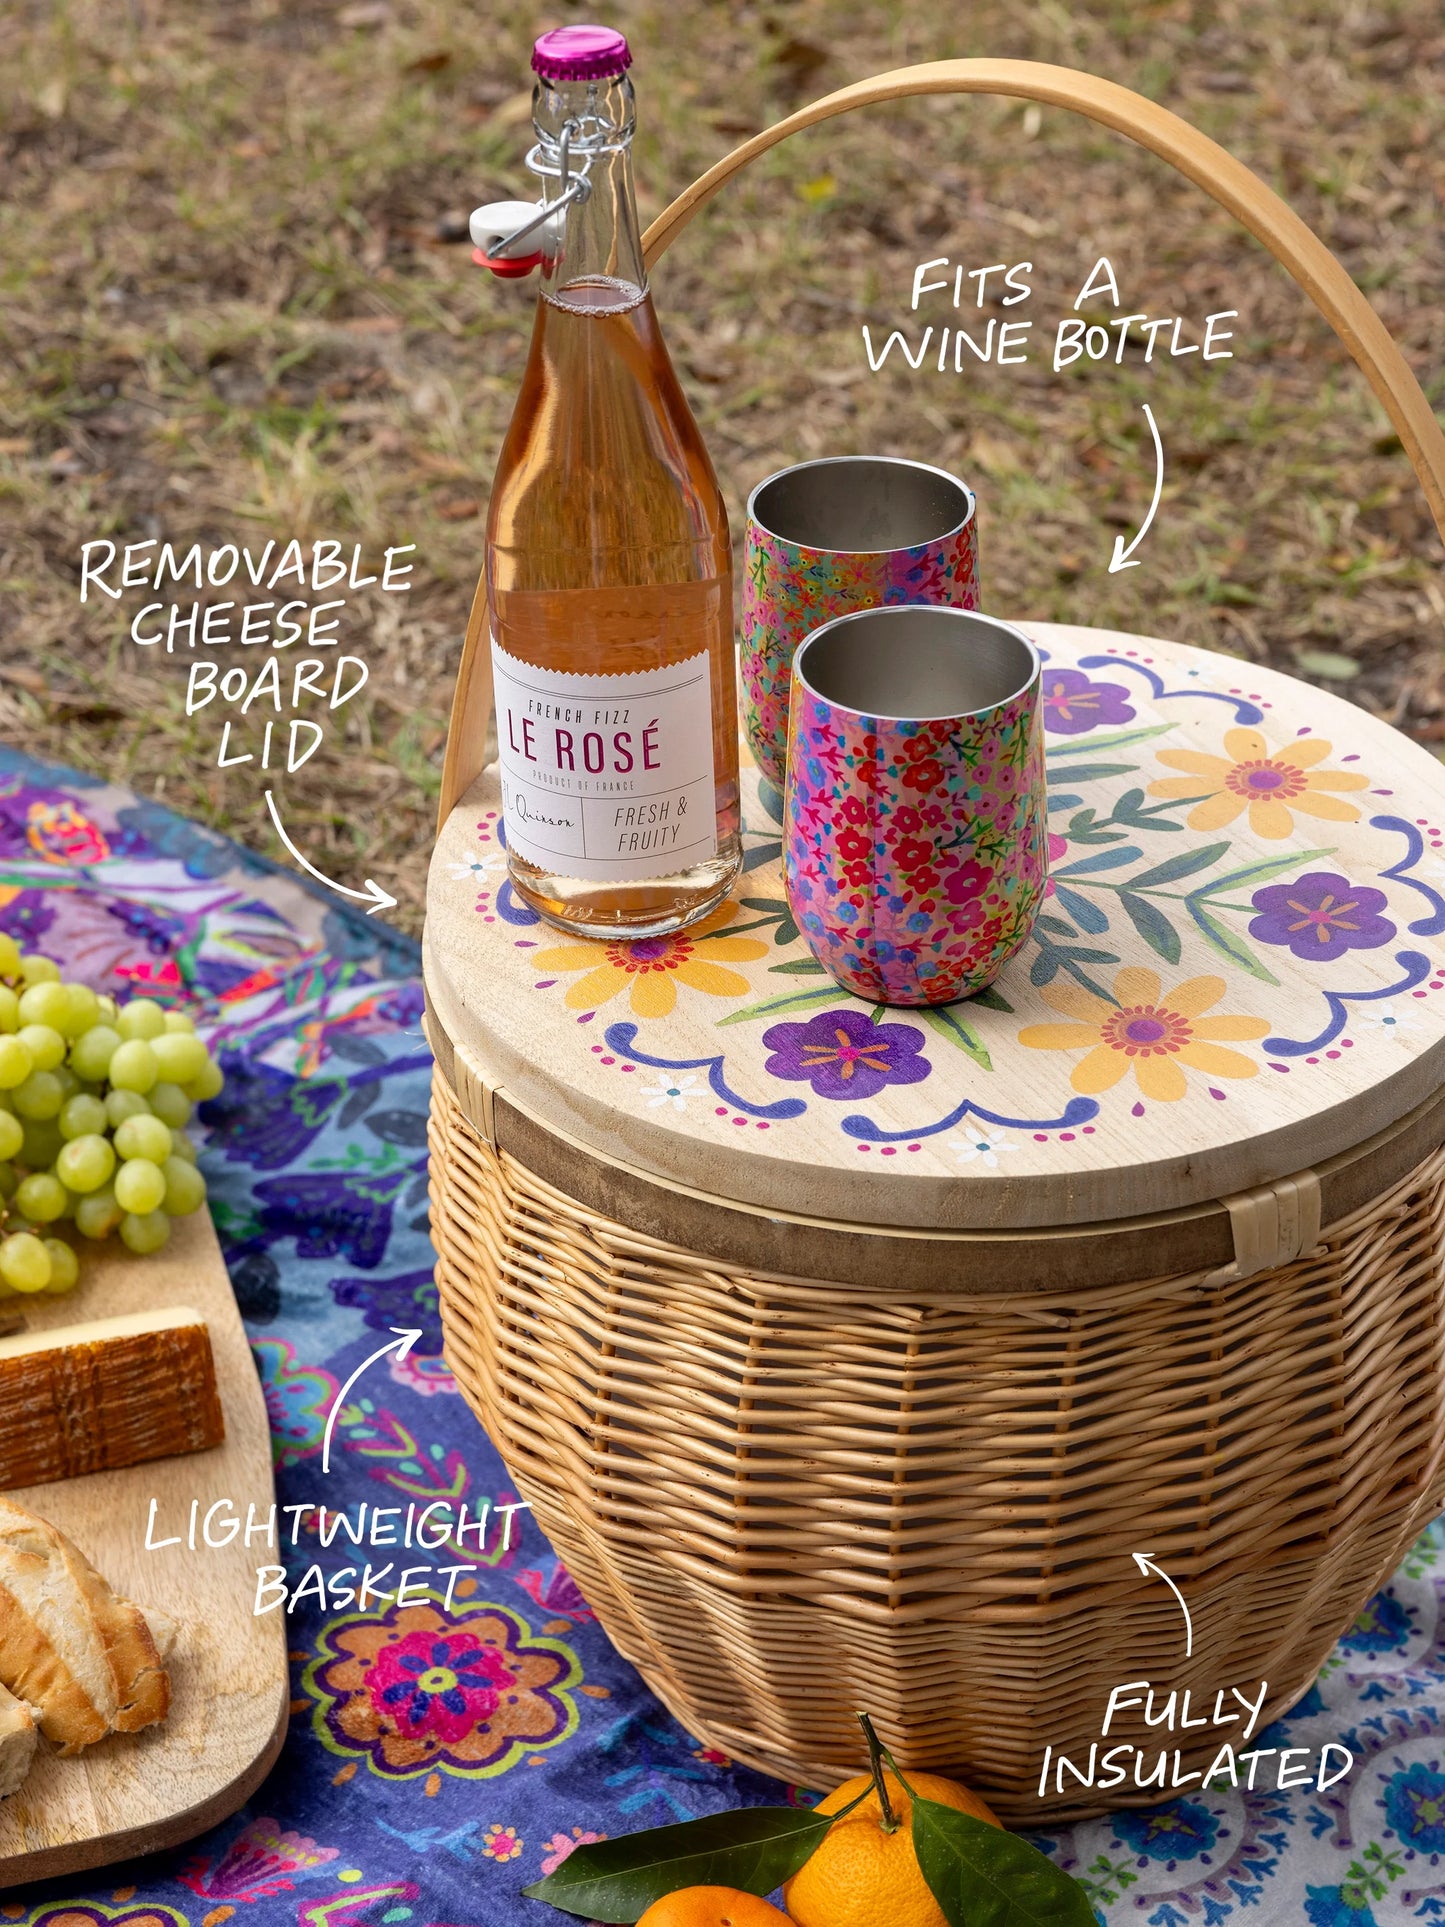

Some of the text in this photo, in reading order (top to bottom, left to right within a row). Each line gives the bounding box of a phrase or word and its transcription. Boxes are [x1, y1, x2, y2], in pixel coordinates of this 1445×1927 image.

[529, 699, 630, 725] FRENCH FIZZ
[507, 708, 661, 774] LE ROSÉ
[532, 769, 634, 792] PRODUCT OF FRANCE
[614, 796, 688, 827] FRESH &
[618, 823, 681, 852] FRUITY
